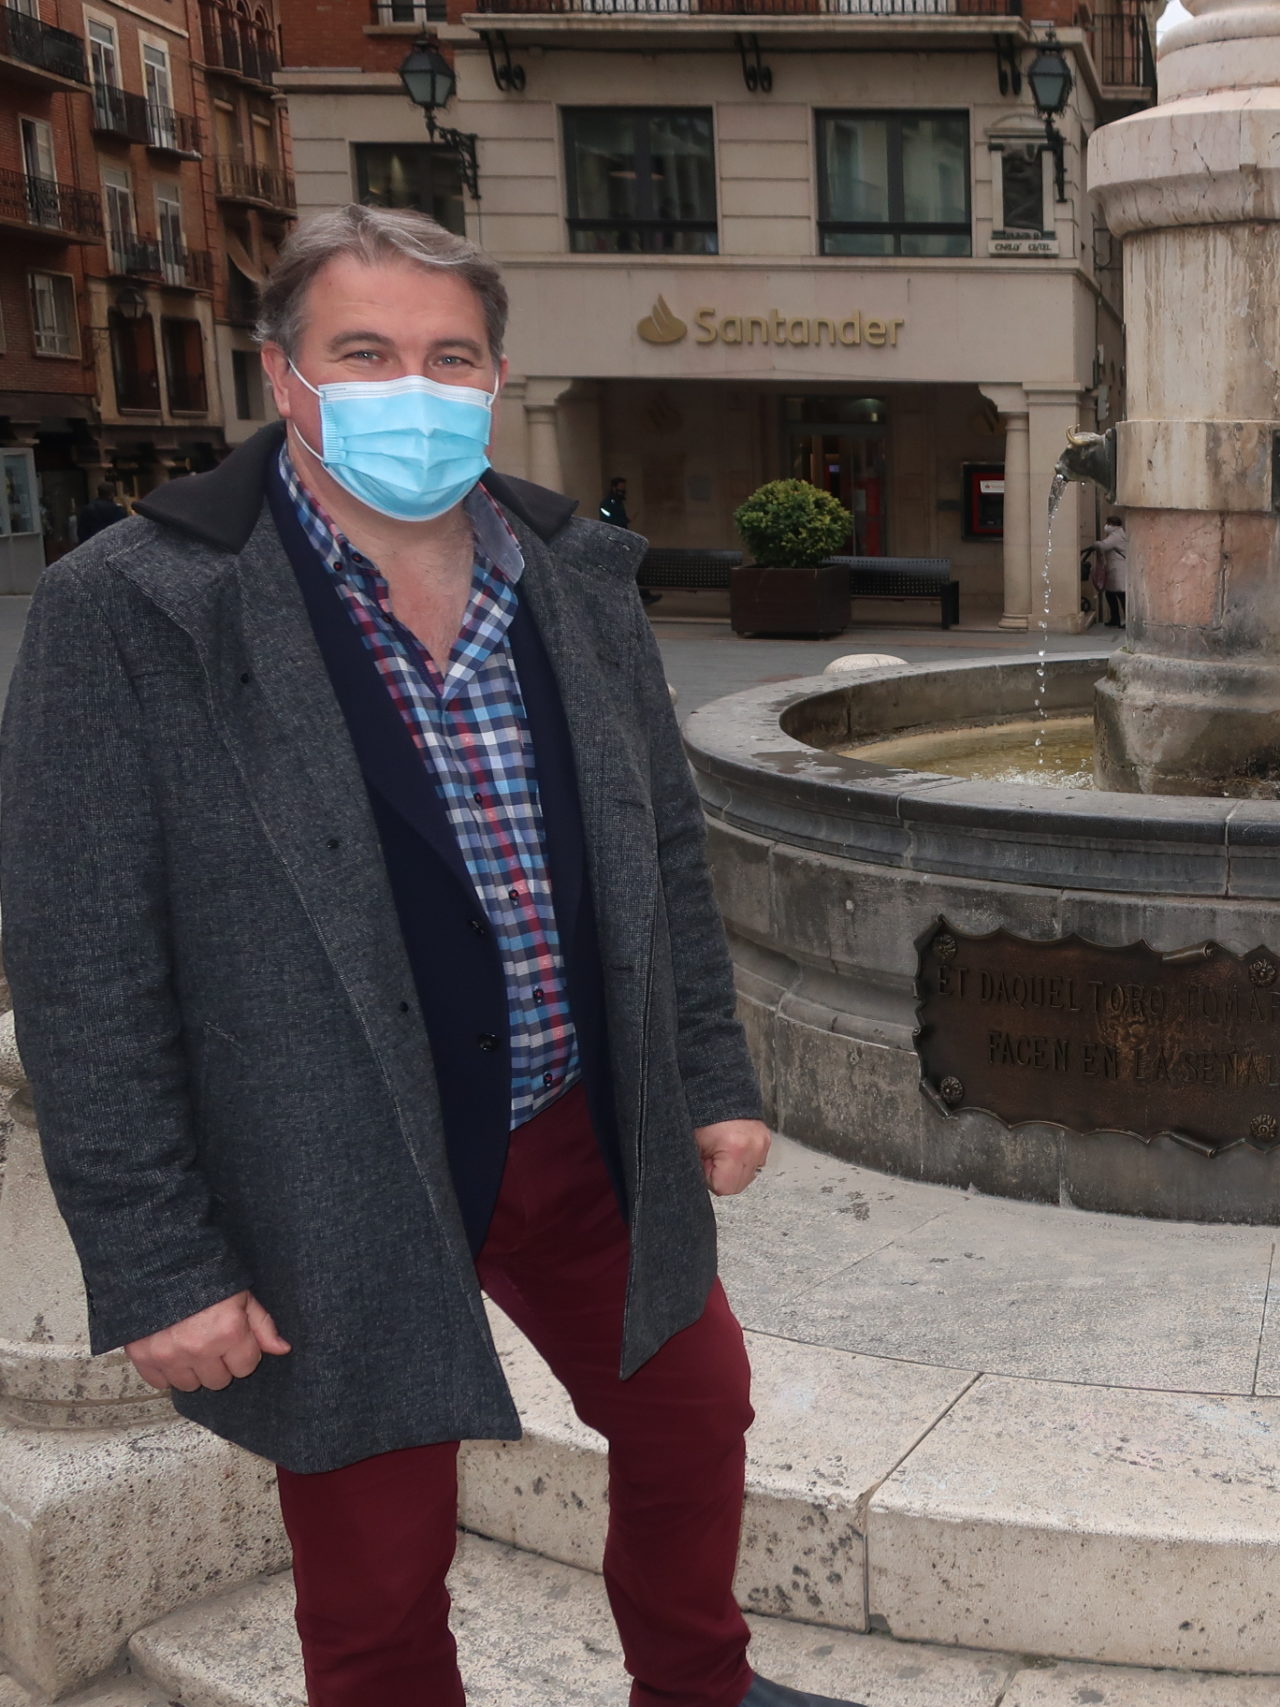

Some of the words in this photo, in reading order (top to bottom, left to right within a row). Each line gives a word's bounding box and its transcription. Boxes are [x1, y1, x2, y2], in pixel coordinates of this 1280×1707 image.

[694, 306, 905, 347] Santander
[937, 964, 970, 1000] ET
[980, 968, 1081, 1011] DAQUEL
[1088, 979, 1166, 1019] TORO
[987, 1030, 1071, 1072] FACEN
[1080, 1040, 1119, 1081] EN
[1132, 1046, 1173, 1082] LA
